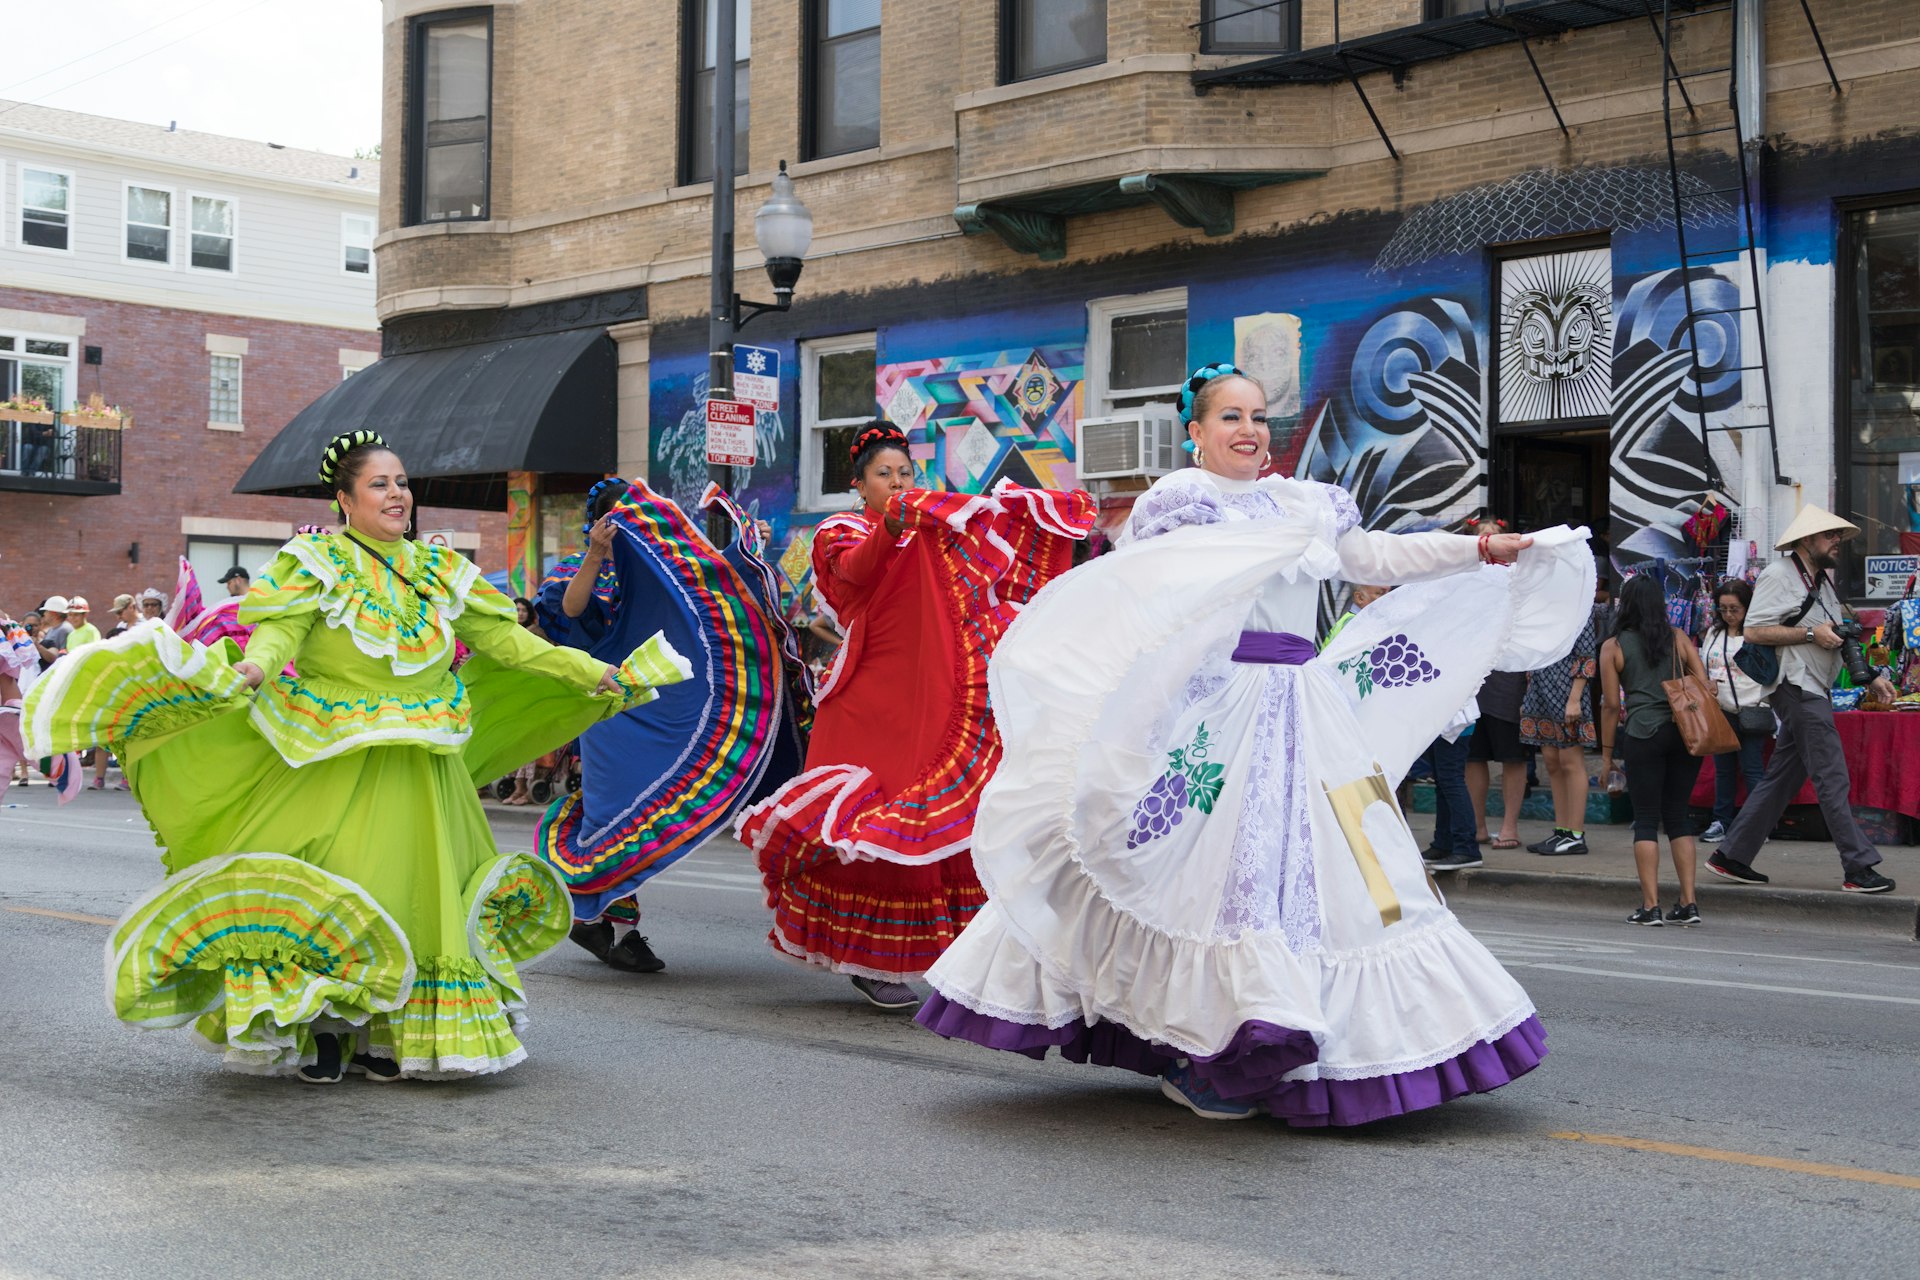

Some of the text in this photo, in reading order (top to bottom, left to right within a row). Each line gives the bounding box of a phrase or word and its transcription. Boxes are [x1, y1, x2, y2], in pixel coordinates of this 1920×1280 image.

[745, 375, 764, 383] PARKING
[755, 391, 772, 399] INCHES
[710, 402, 738, 414] STREET
[754, 399, 774, 410] ZONE
[710, 411, 750, 423] CLEANING
[720, 424, 742, 432] PARKING
[390, 420, 515, 455] FFICE
[728, 439, 746, 447] THURS
[711, 453, 751, 465] TOW ZONE
[1869, 559, 1915, 572] NOTICE
